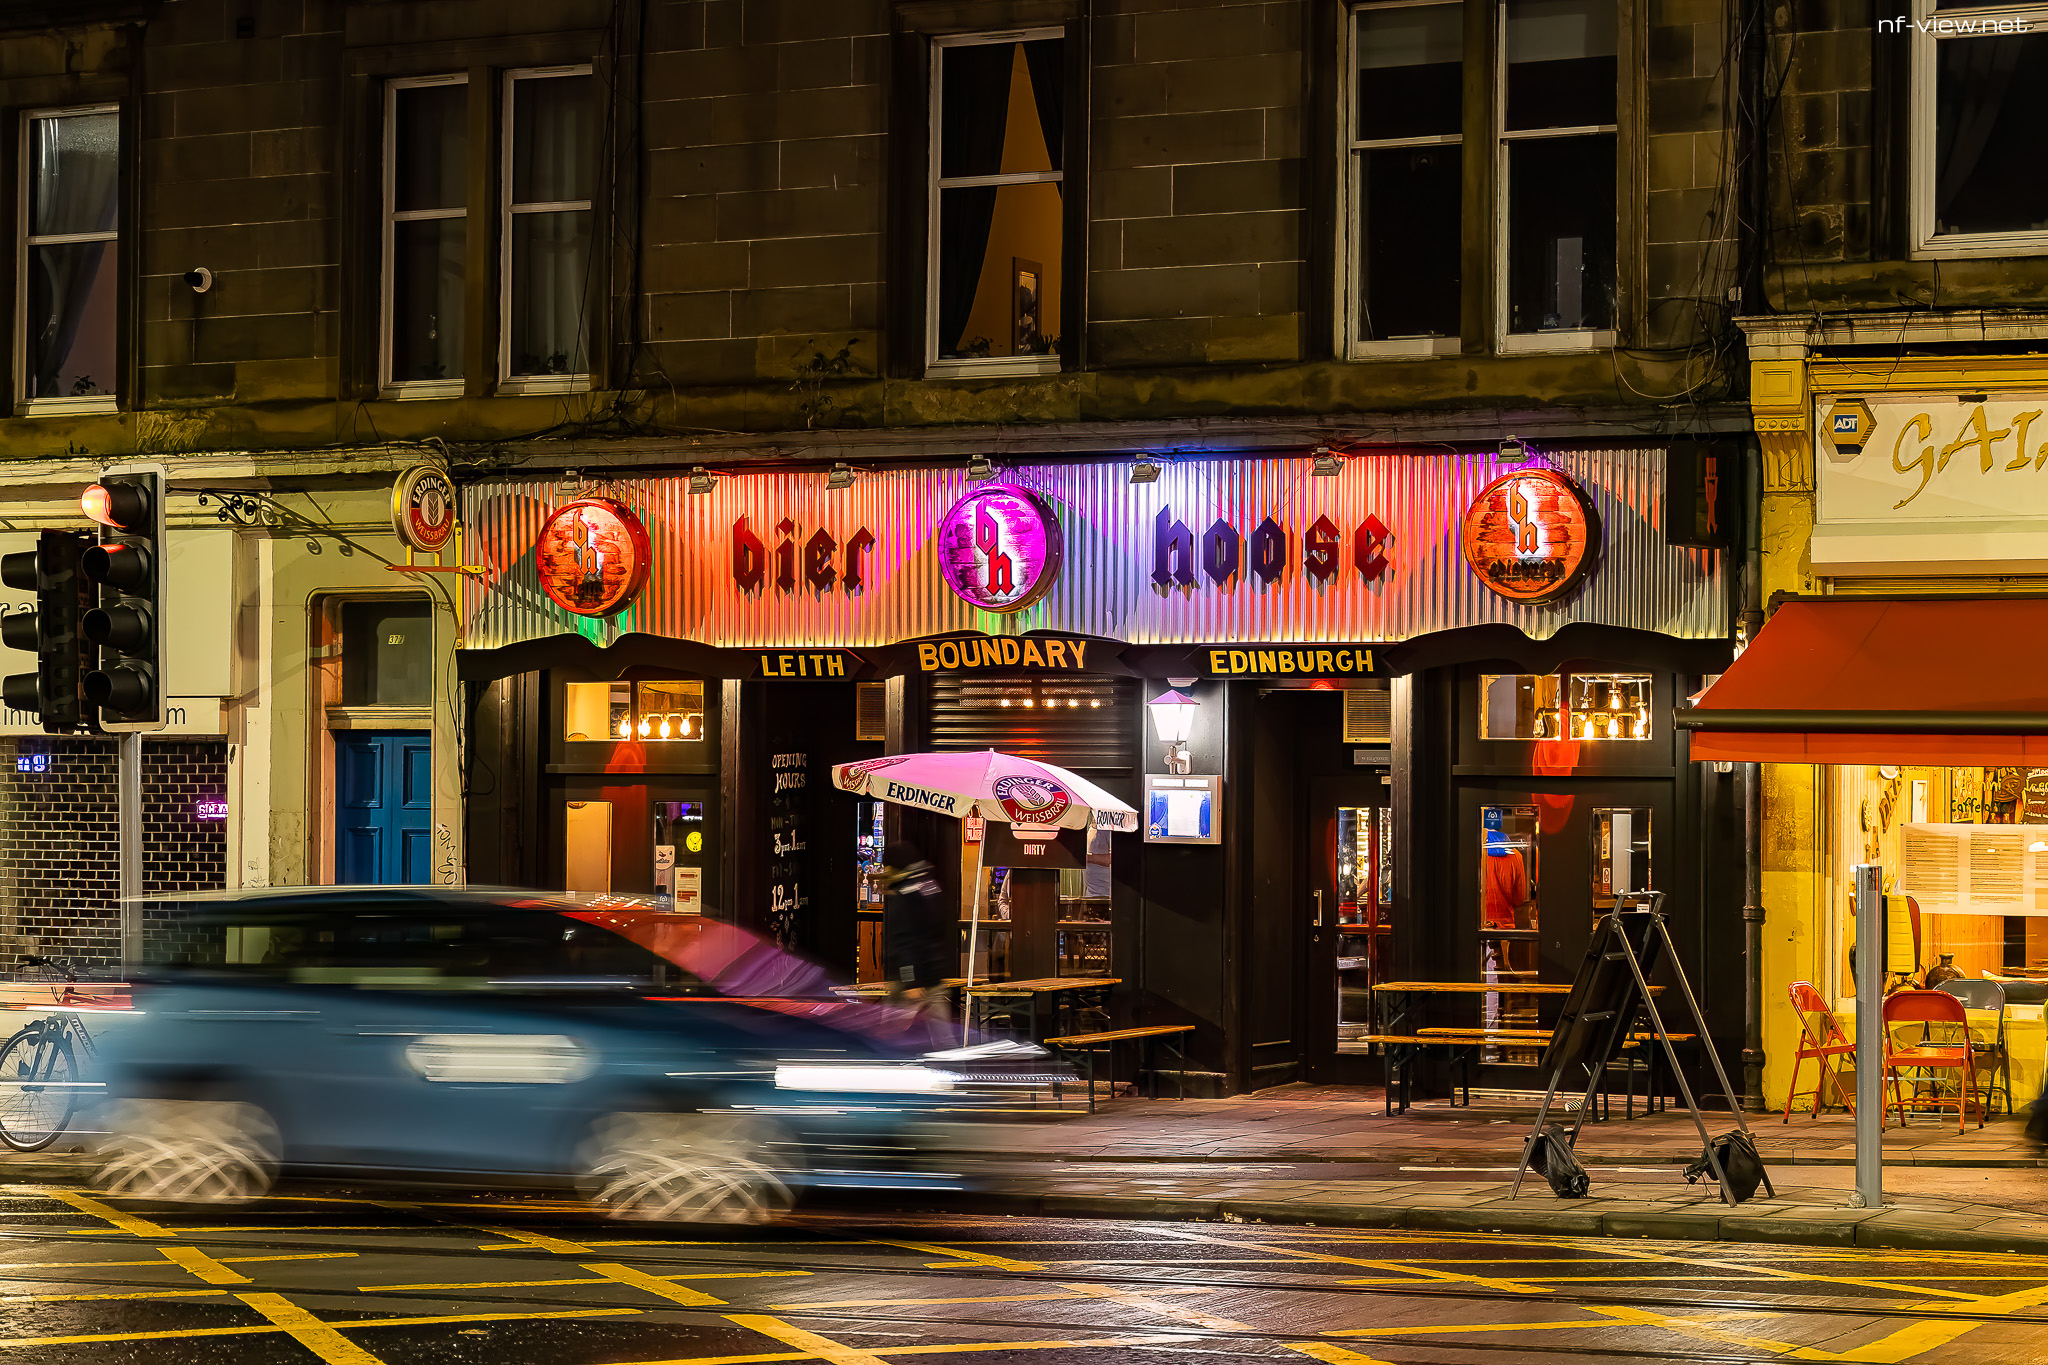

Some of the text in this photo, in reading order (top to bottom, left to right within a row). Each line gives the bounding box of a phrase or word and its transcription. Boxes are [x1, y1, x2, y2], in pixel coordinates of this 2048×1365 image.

[1834, 418, 1858, 429] ADT
[1893, 405, 2048, 510] GAI
[412, 477, 451, 504] ERDINGER
[733, 503, 1391, 594] bier hoose
[918, 638, 1087, 671] BOUNDARY
[1210, 650, 1374, 674] EDINBURGH
[761, 655, 844, 677] LEITH
[771, 752, 807, 769] OPENING
[774, 772, 806, 794] HOURS
[997, 777, 1054, 796] ERDINGER
[886, 782, 956, 814] ERDINGER
[1096, 810, 1125, 828] ERDINGER
[1023, 844, 1046, 856] DIRTY
